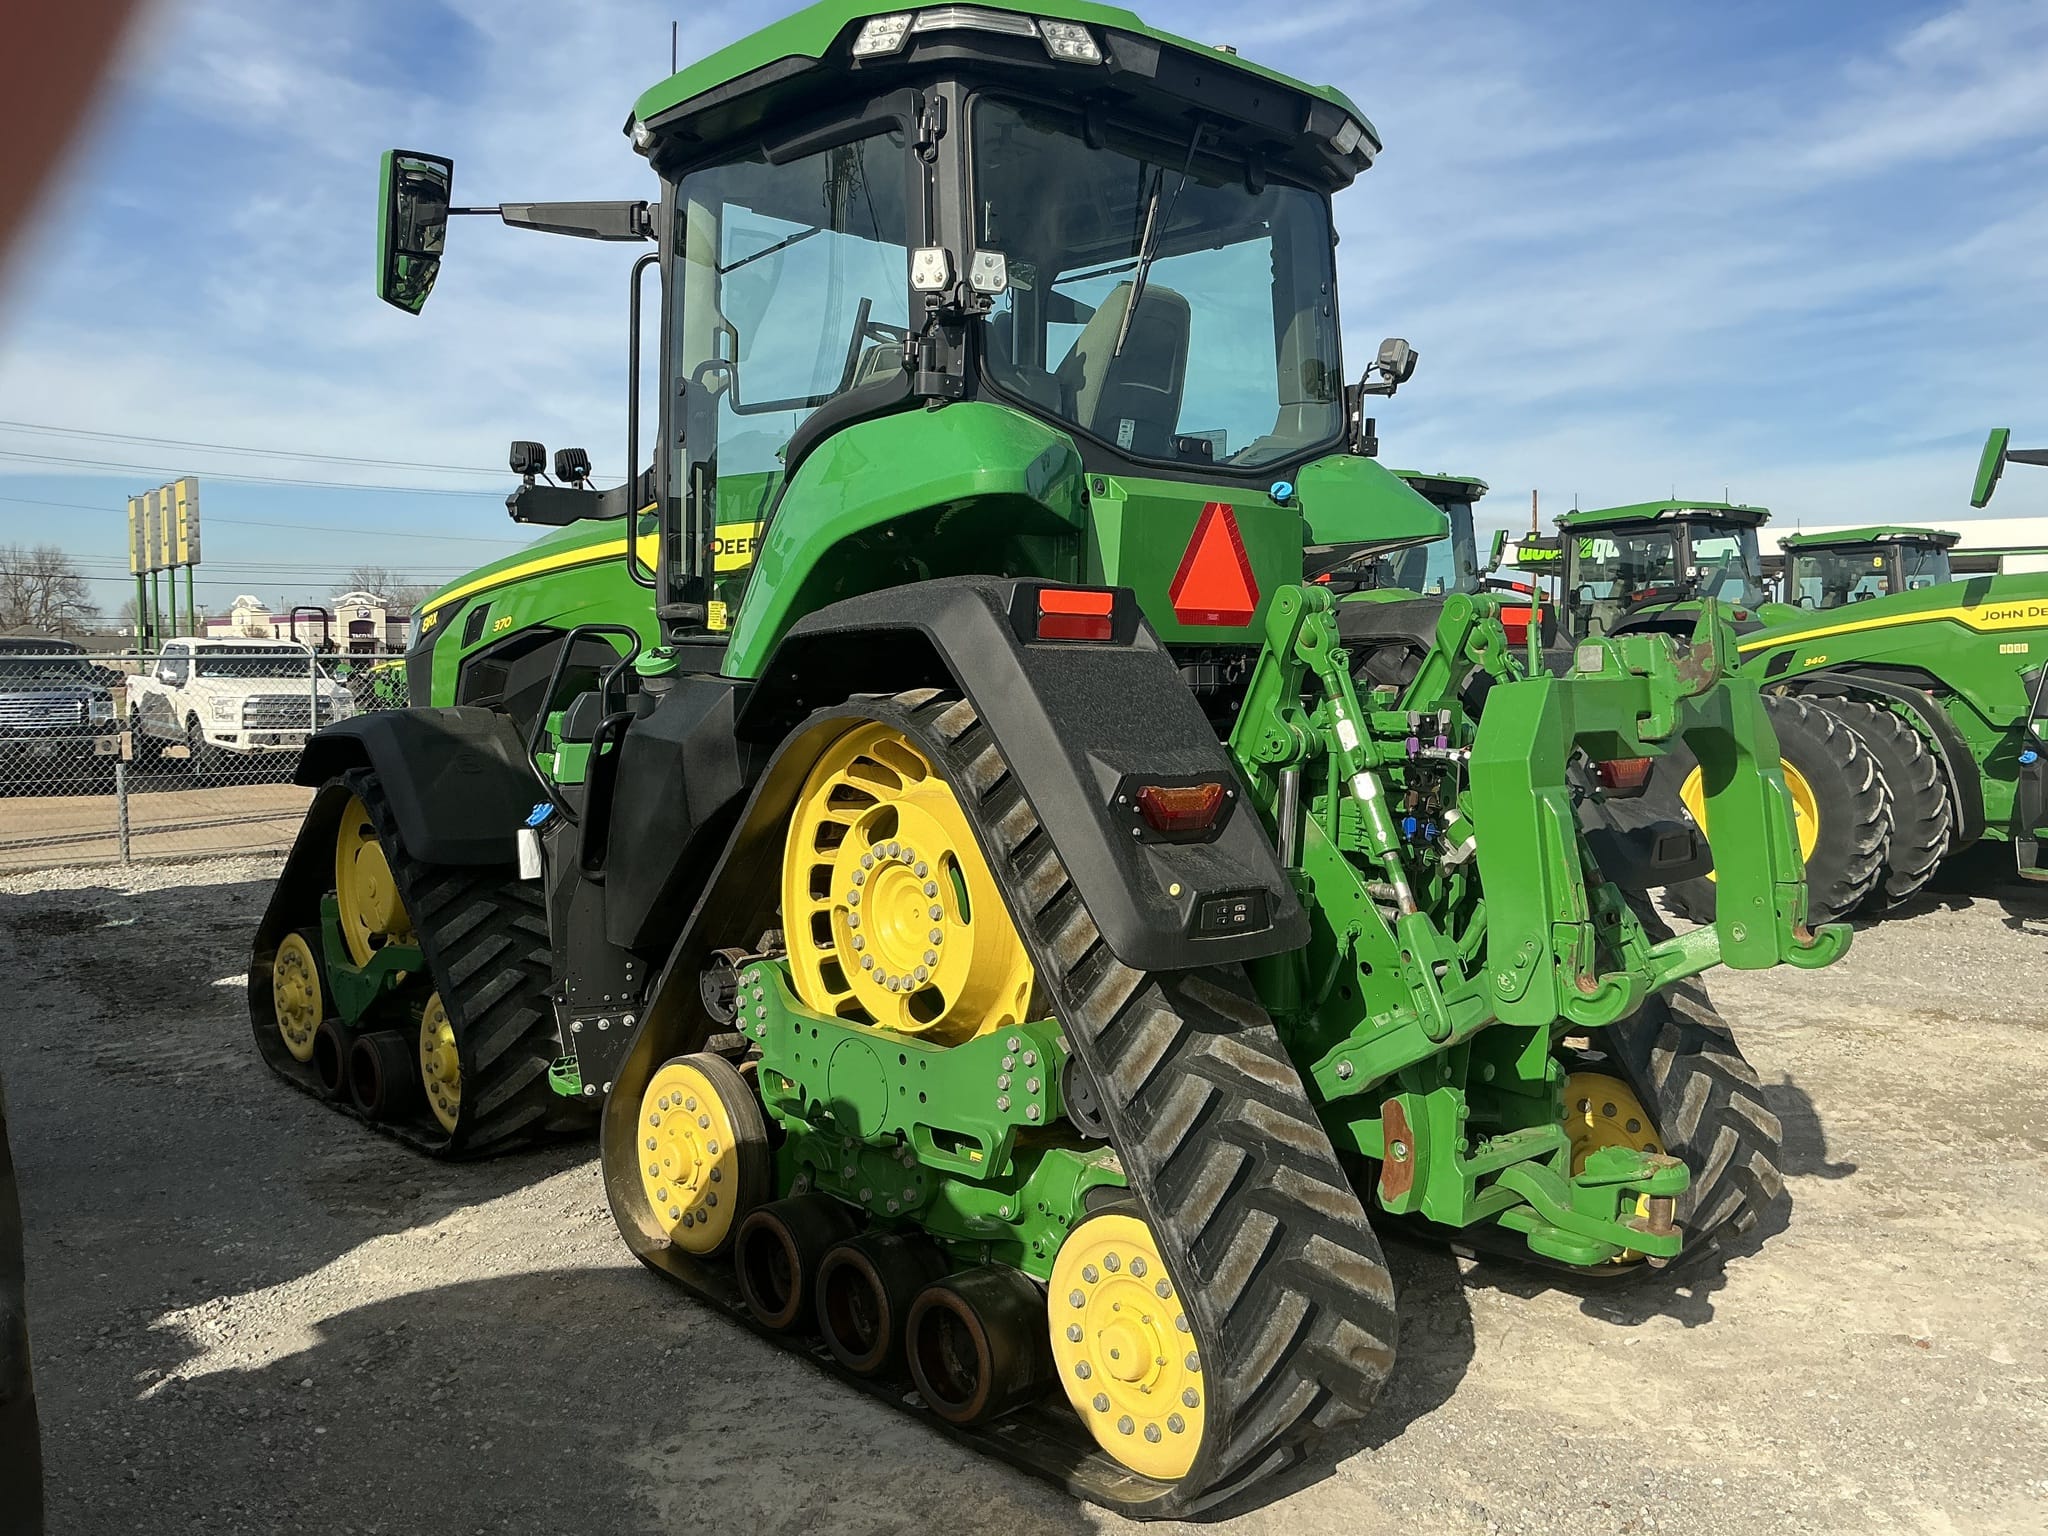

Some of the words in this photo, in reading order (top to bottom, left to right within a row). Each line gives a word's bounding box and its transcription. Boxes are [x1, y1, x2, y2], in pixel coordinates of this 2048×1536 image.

[1873, 557, 1882, 568] 8
[1981, 609, 2024, 621] JOHN
[421, 610, 439, 633] 8RX
[493, 615, 513, 632] 370
[1803, 655, 1828, 667] 340
